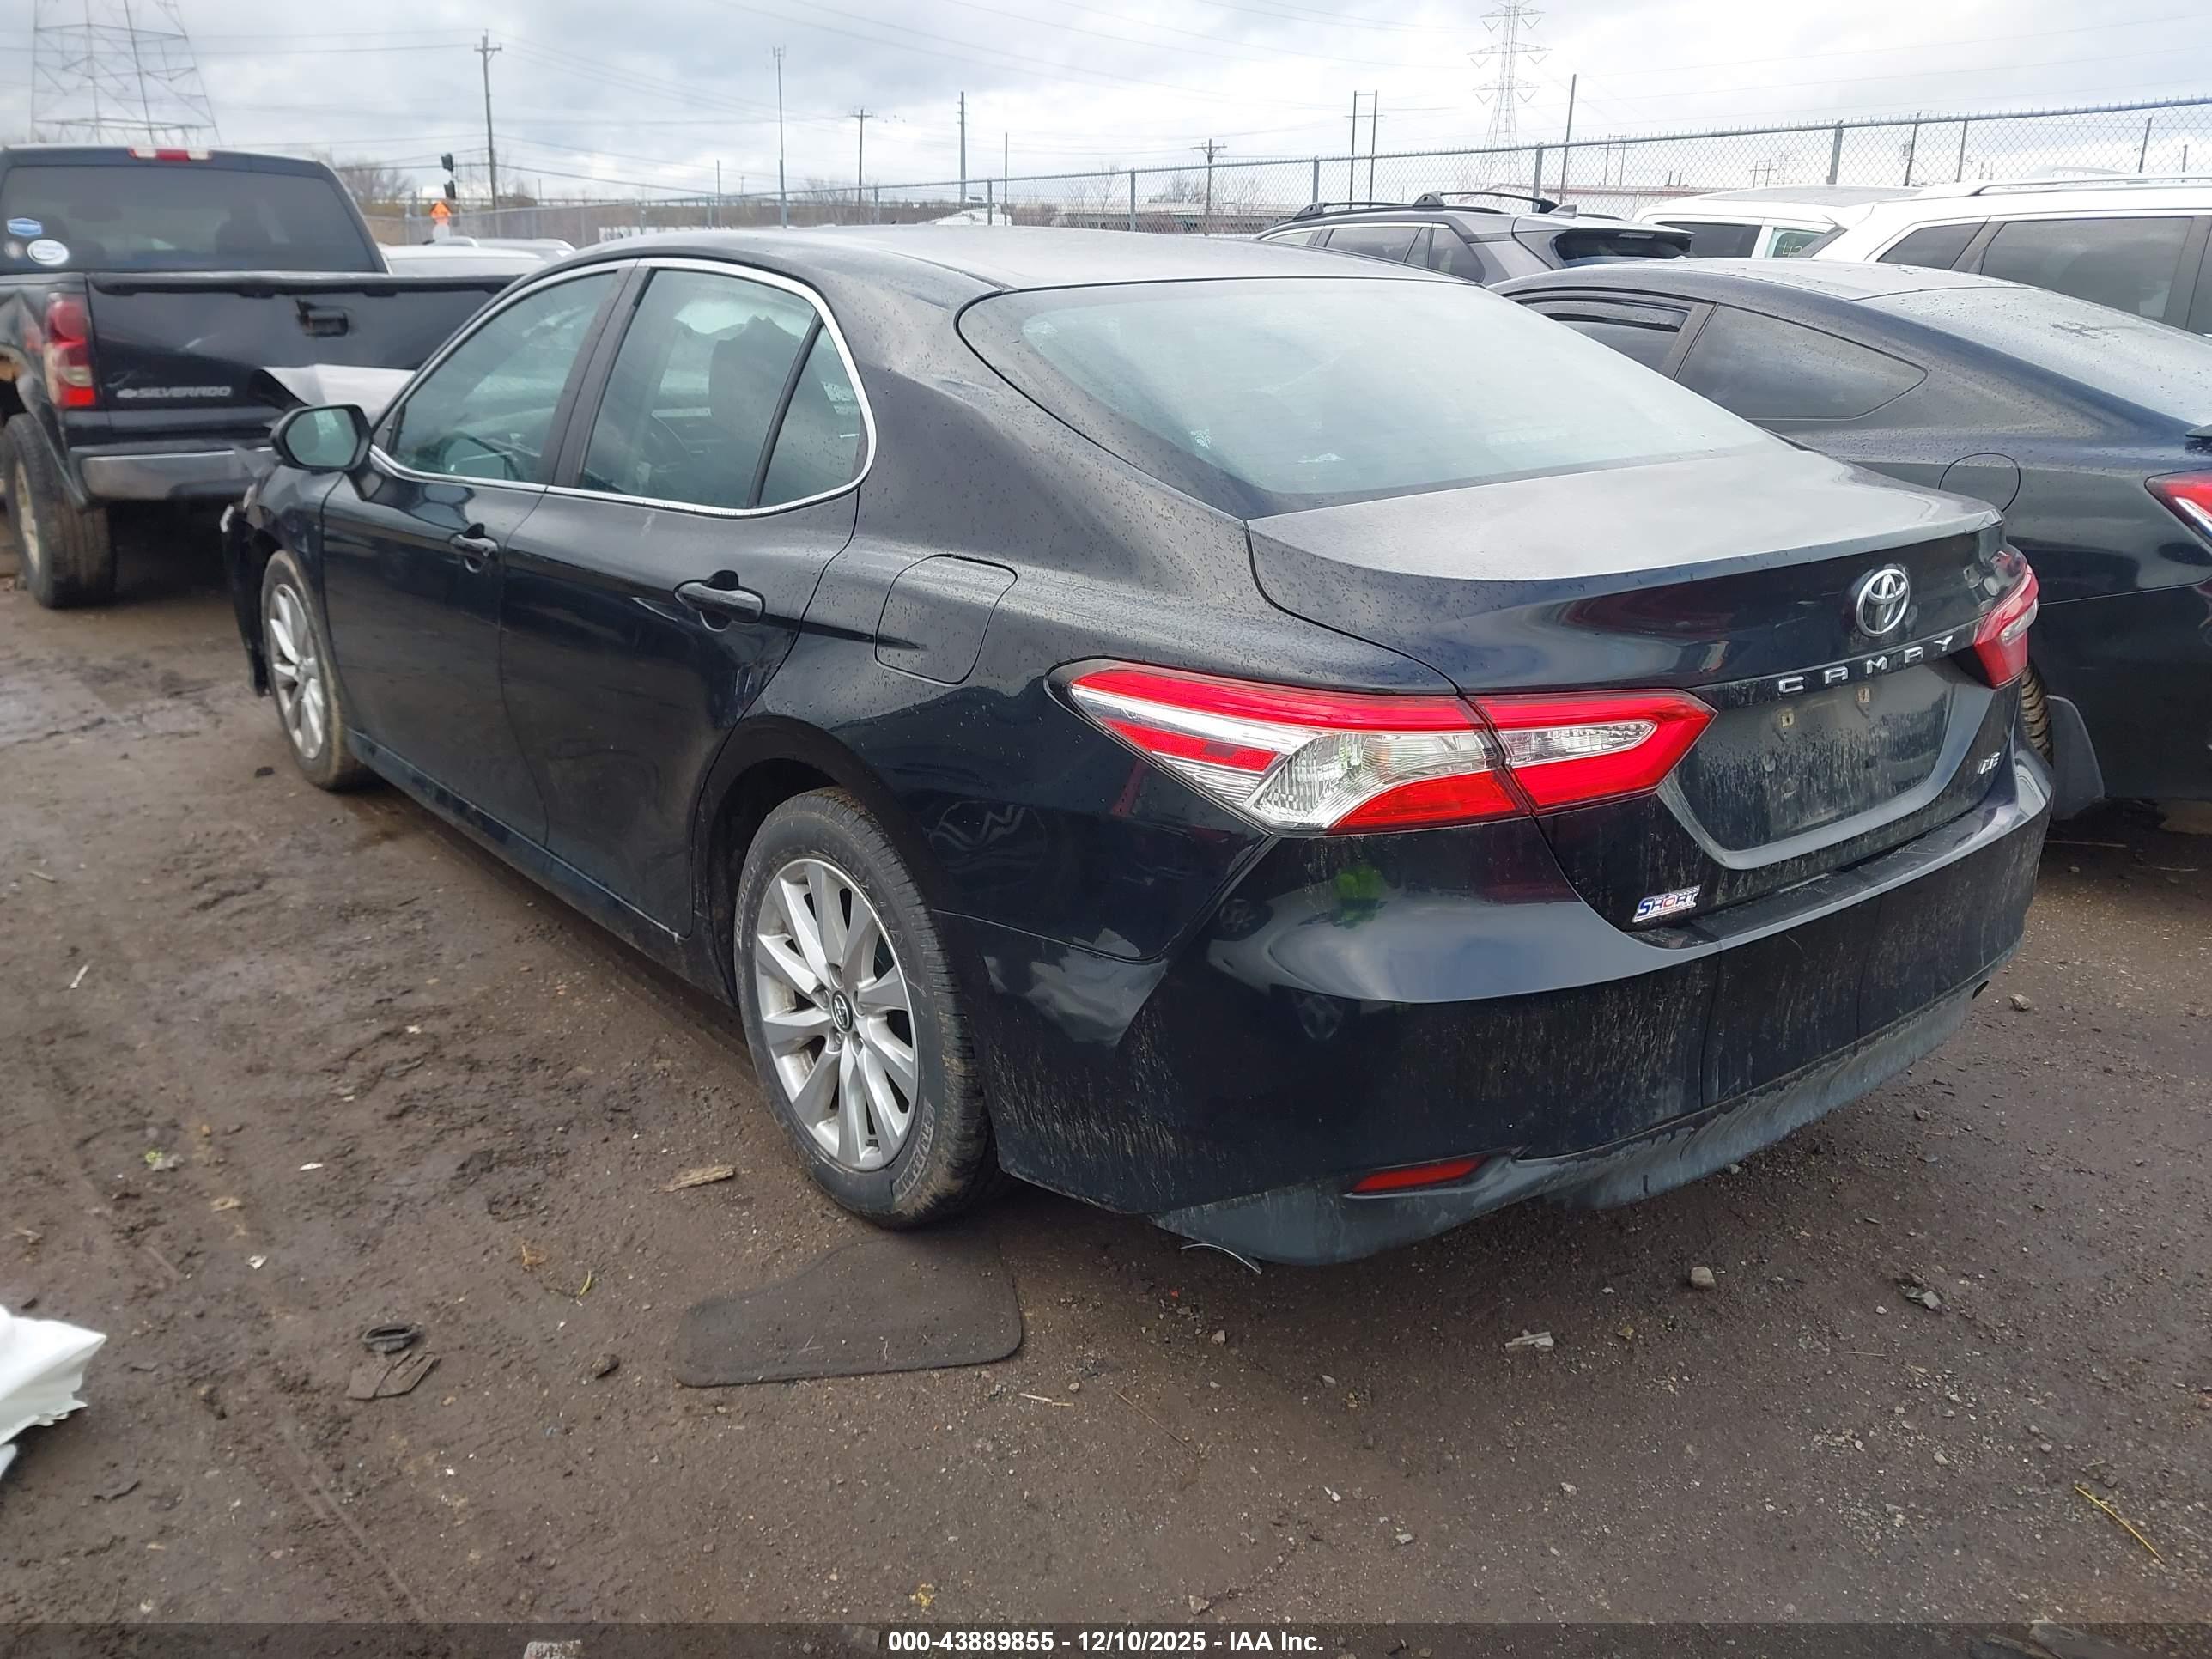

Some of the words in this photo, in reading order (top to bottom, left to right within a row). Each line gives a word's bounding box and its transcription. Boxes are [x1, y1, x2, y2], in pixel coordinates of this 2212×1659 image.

[137, 386, 231, 398] SILVERADO
[1778, 635, 1954, 694] CAMRY
[1636, 892, 1698, 917] SHORT
